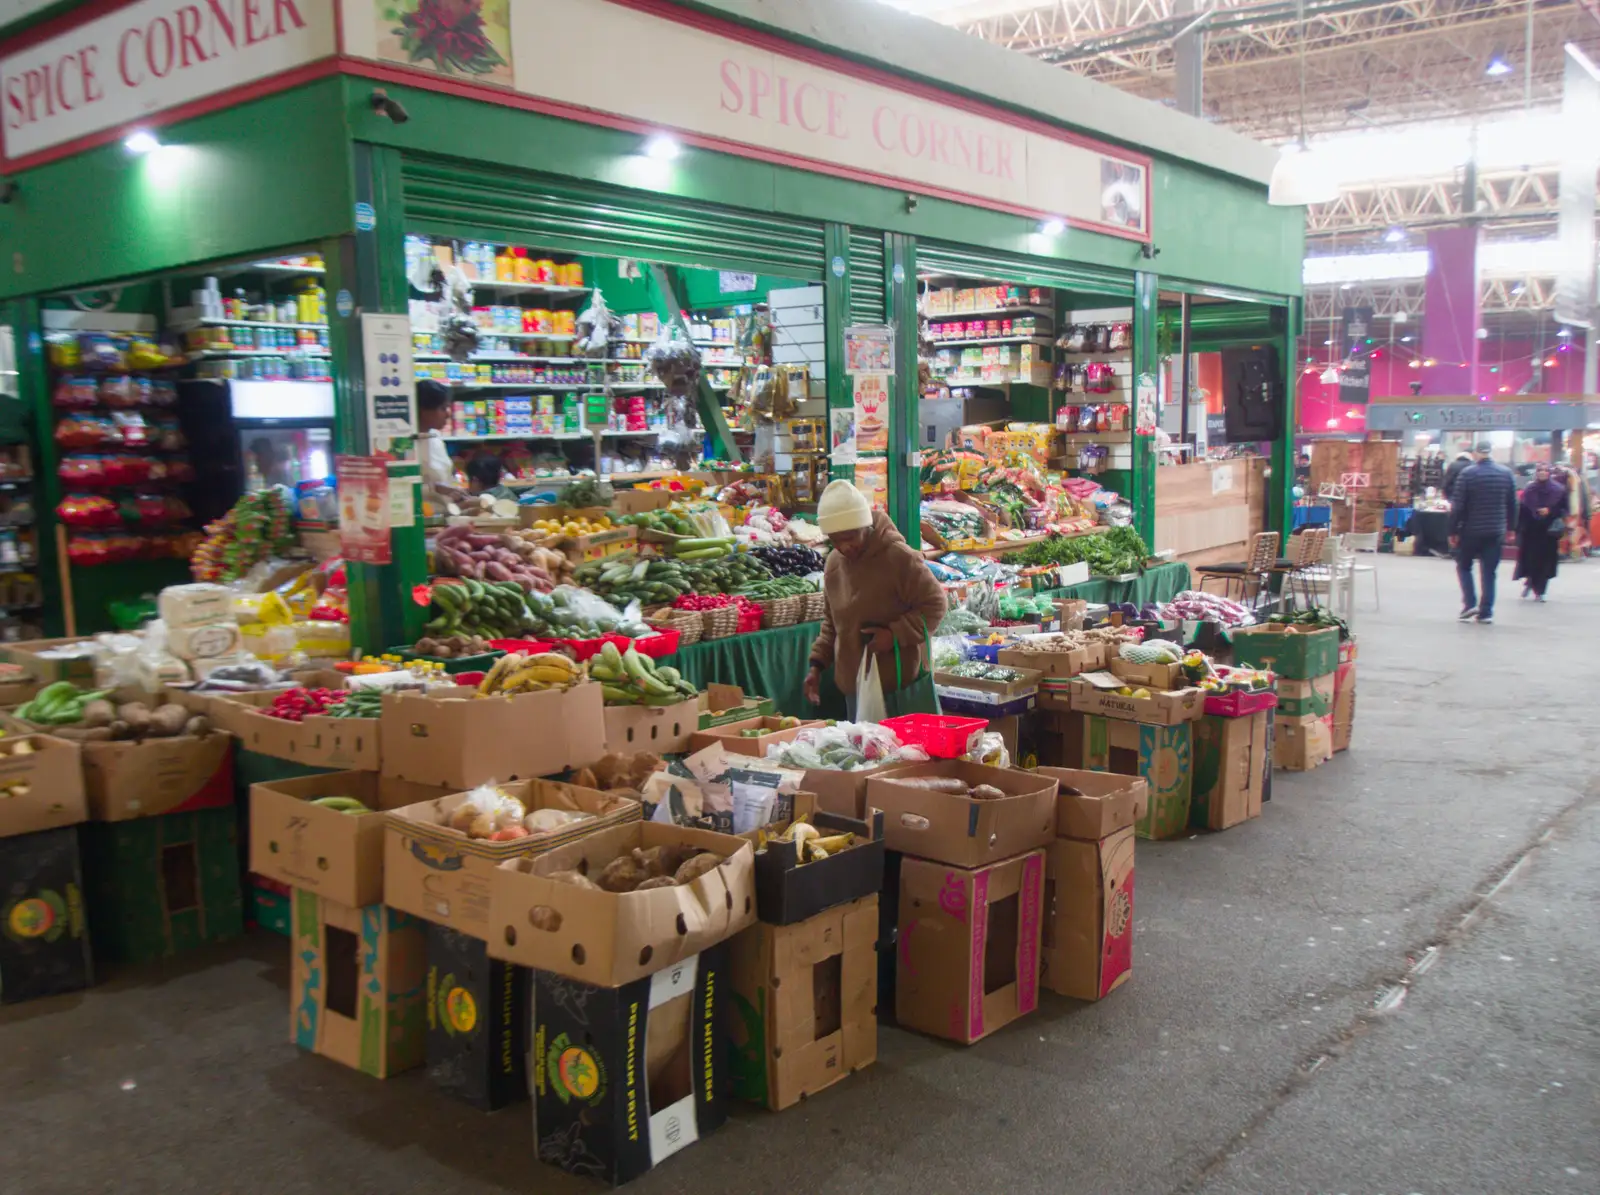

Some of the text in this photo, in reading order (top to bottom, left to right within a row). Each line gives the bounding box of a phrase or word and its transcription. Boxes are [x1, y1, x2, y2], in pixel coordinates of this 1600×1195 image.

[5, 0, 307, 130] SPICE CORNER
[719, 58, 1016, 181] SPICE CORNER
[503, 962, 515, 1025] REMIUM
[704, 970, 715, 1102] PREMIUM FRUIT
[626, 1001, 639, 1141] PREMIUM FRUIT
